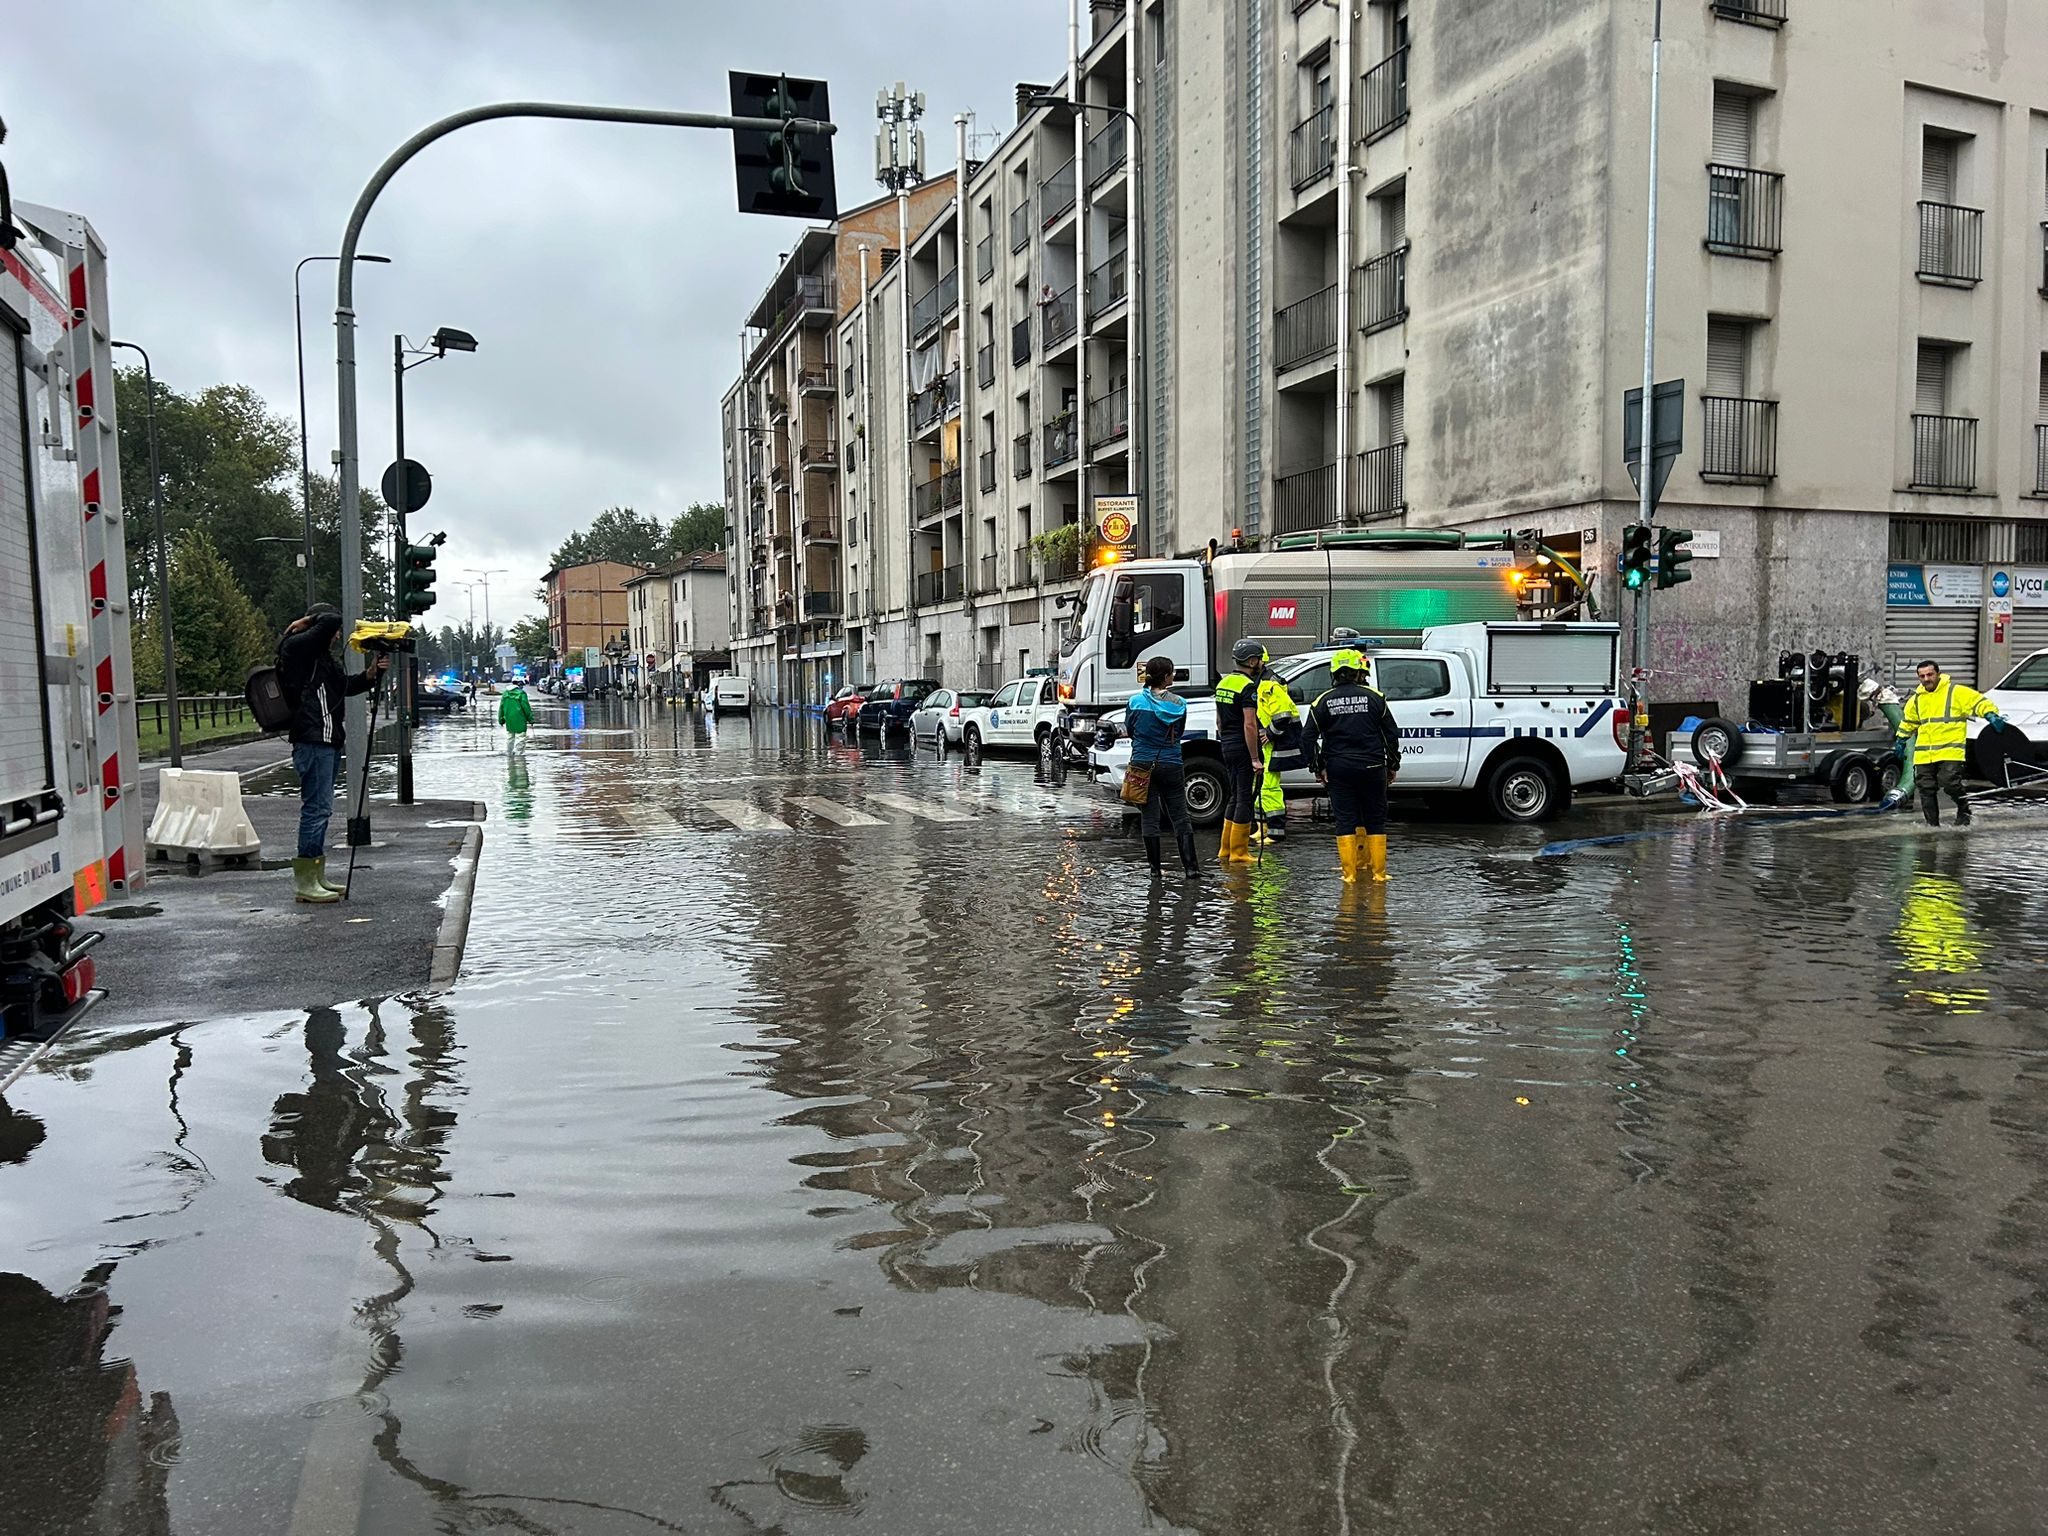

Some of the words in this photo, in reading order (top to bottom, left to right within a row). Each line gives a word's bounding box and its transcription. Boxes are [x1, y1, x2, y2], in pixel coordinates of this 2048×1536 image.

[1584, 530, 1594, 540] 26
[2015, 576, 2042, 593] Lyca
[1270, 607, 1295, 618] MM
[1326, 697, 1345, 707] COMUNE
[1345, 697, 1351, 705] DI
[1351, 696, 1368, 704] MILANO
[1329, 705, 1354, 715] PROTEZIONE
[1354, 704, 1368, 713] CIVILE
[1401, 728, 1441, 737] IVILE
[0, 873, 22, 896] OMUNE
[23, 870, 30, 884] DI
[31, 860, 51, 881] MILANO
